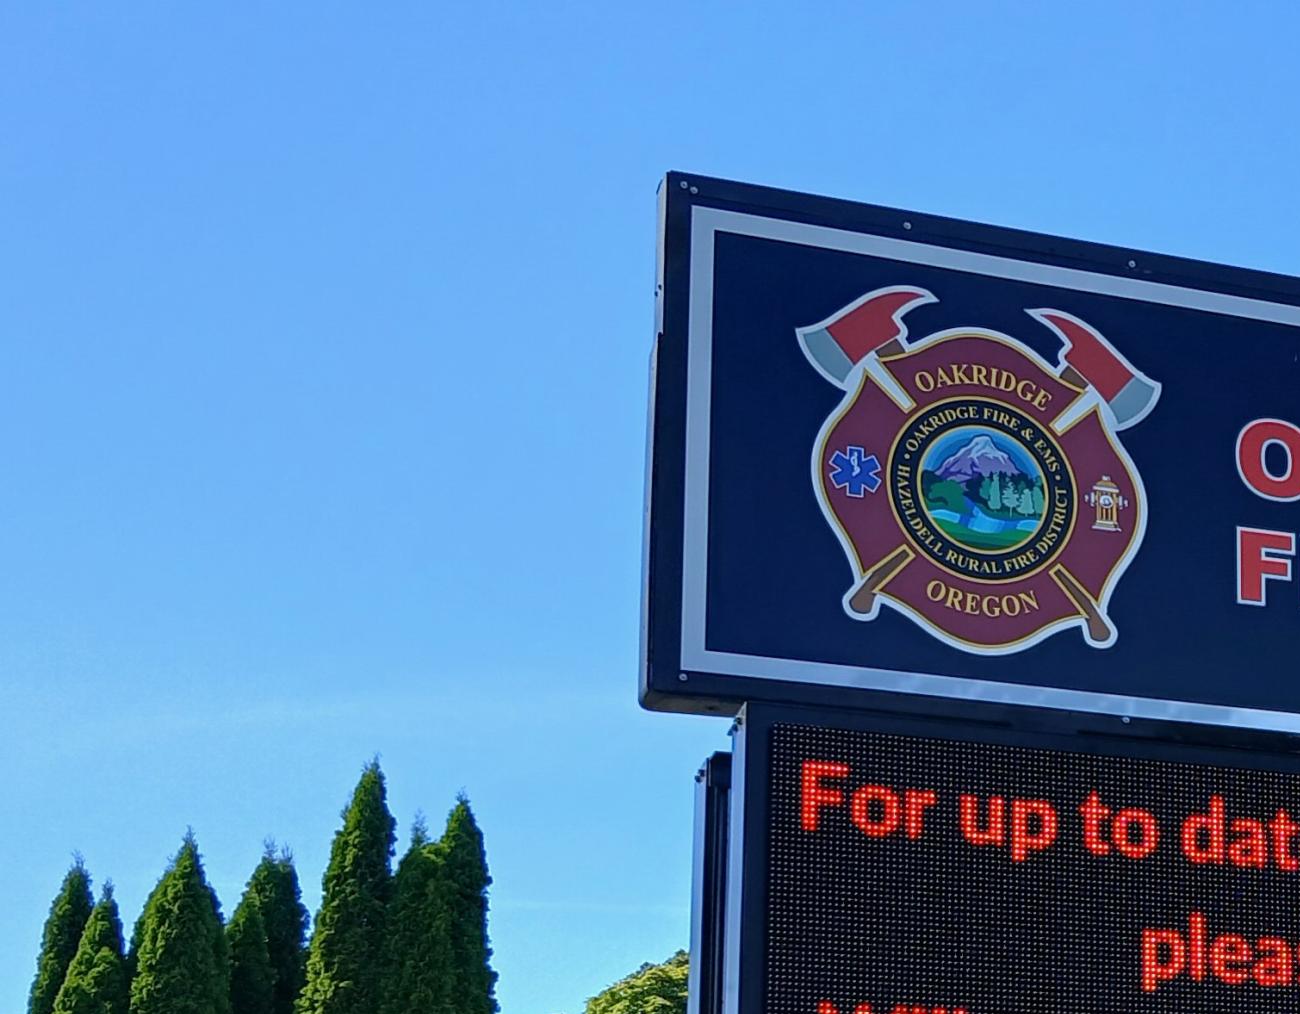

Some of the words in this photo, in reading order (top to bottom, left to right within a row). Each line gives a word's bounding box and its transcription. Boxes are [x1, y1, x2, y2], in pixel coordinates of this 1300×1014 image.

[914, 363, 1053, 411] OAKRIDGE
[905, 406, 979, 452] OAKRIDGE
[983, 407, 1021, 431] FIRE
[1021, 427, 1034, 442] &
[1034, 439, 1061, 473] EMS
[896, 464, 944, 557] HAZELDELL
[946, 551, 1002, 574] RURAL
[1004, 548, 1040, 572] FIRE
[1036, 486, 1068, 554] DISTRICT
[926, 579, 1041, 618] OREGON
[800, 759, 938, 842] For
[959, 791, 1059, 863] up
[1079, 789, 1160, 860] to
